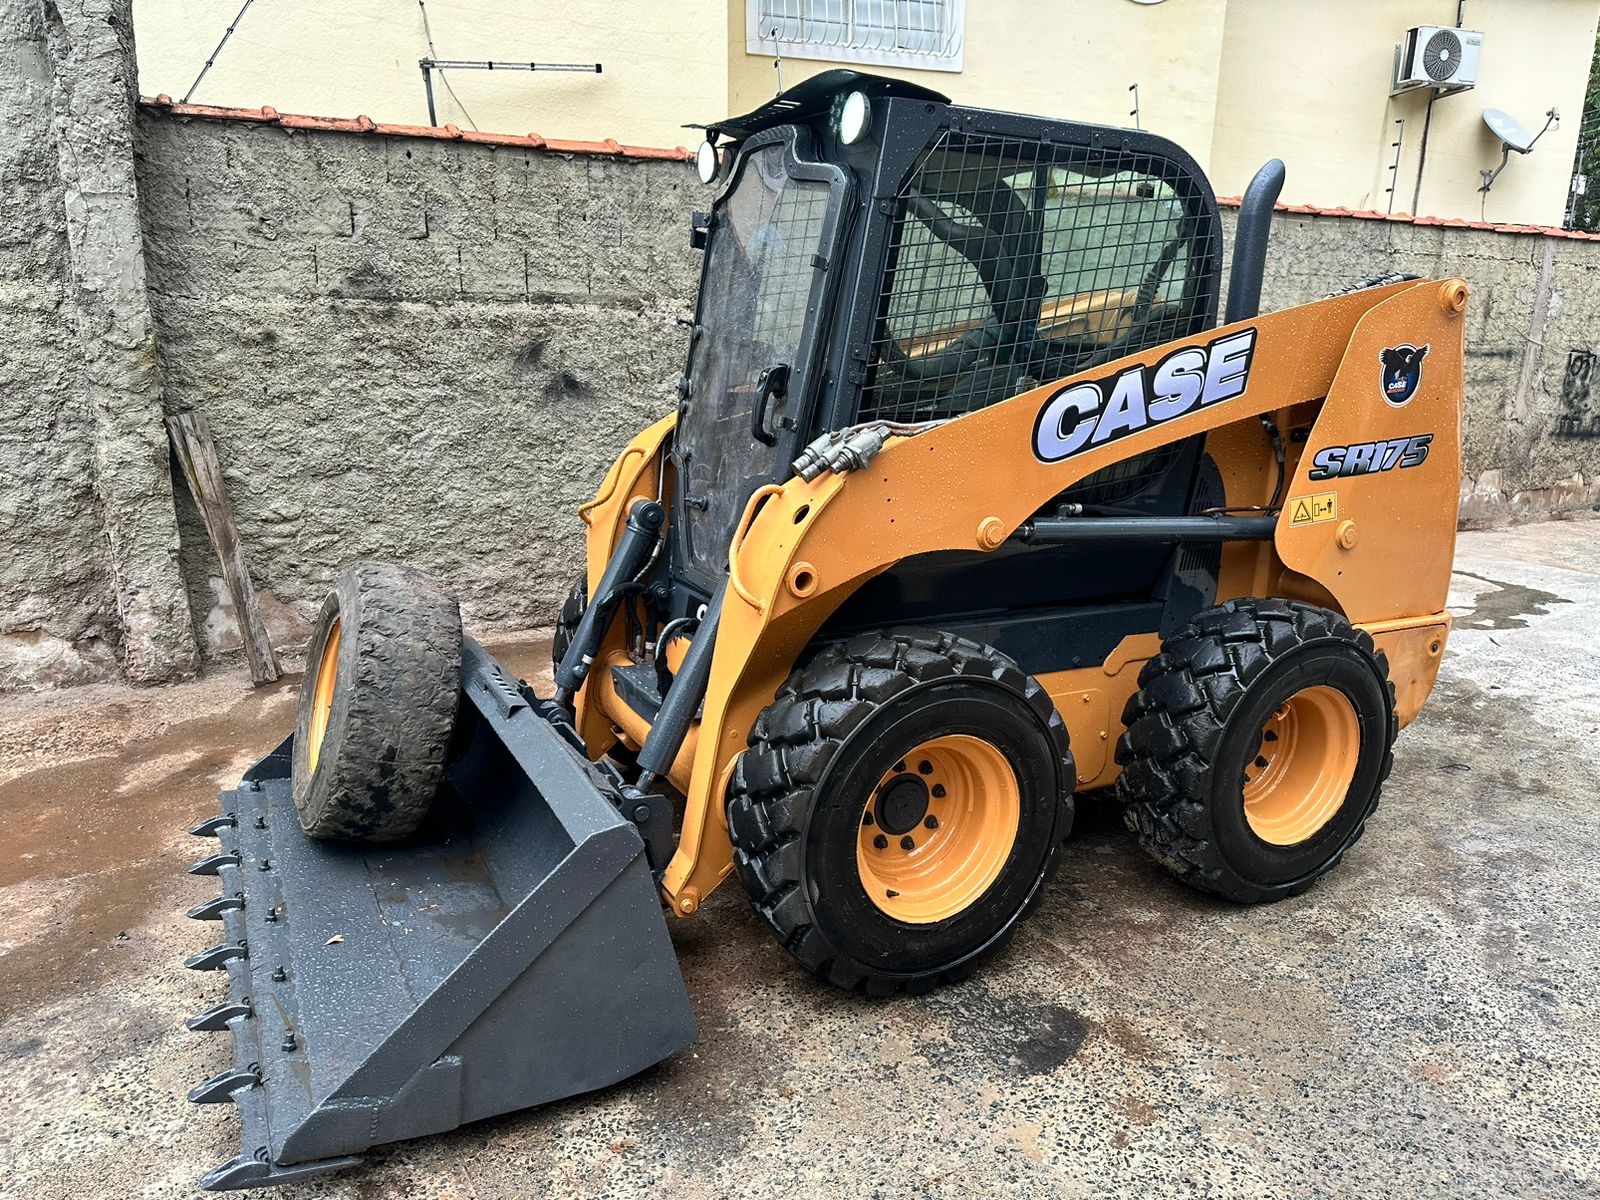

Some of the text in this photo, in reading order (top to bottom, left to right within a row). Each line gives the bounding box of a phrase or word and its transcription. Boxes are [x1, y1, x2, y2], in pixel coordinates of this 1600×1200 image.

[1034, 328, 1256, 461] CASE
[1388, 381, 1407, 390] CASE
[1309, 434, 1433, 480] SR175
